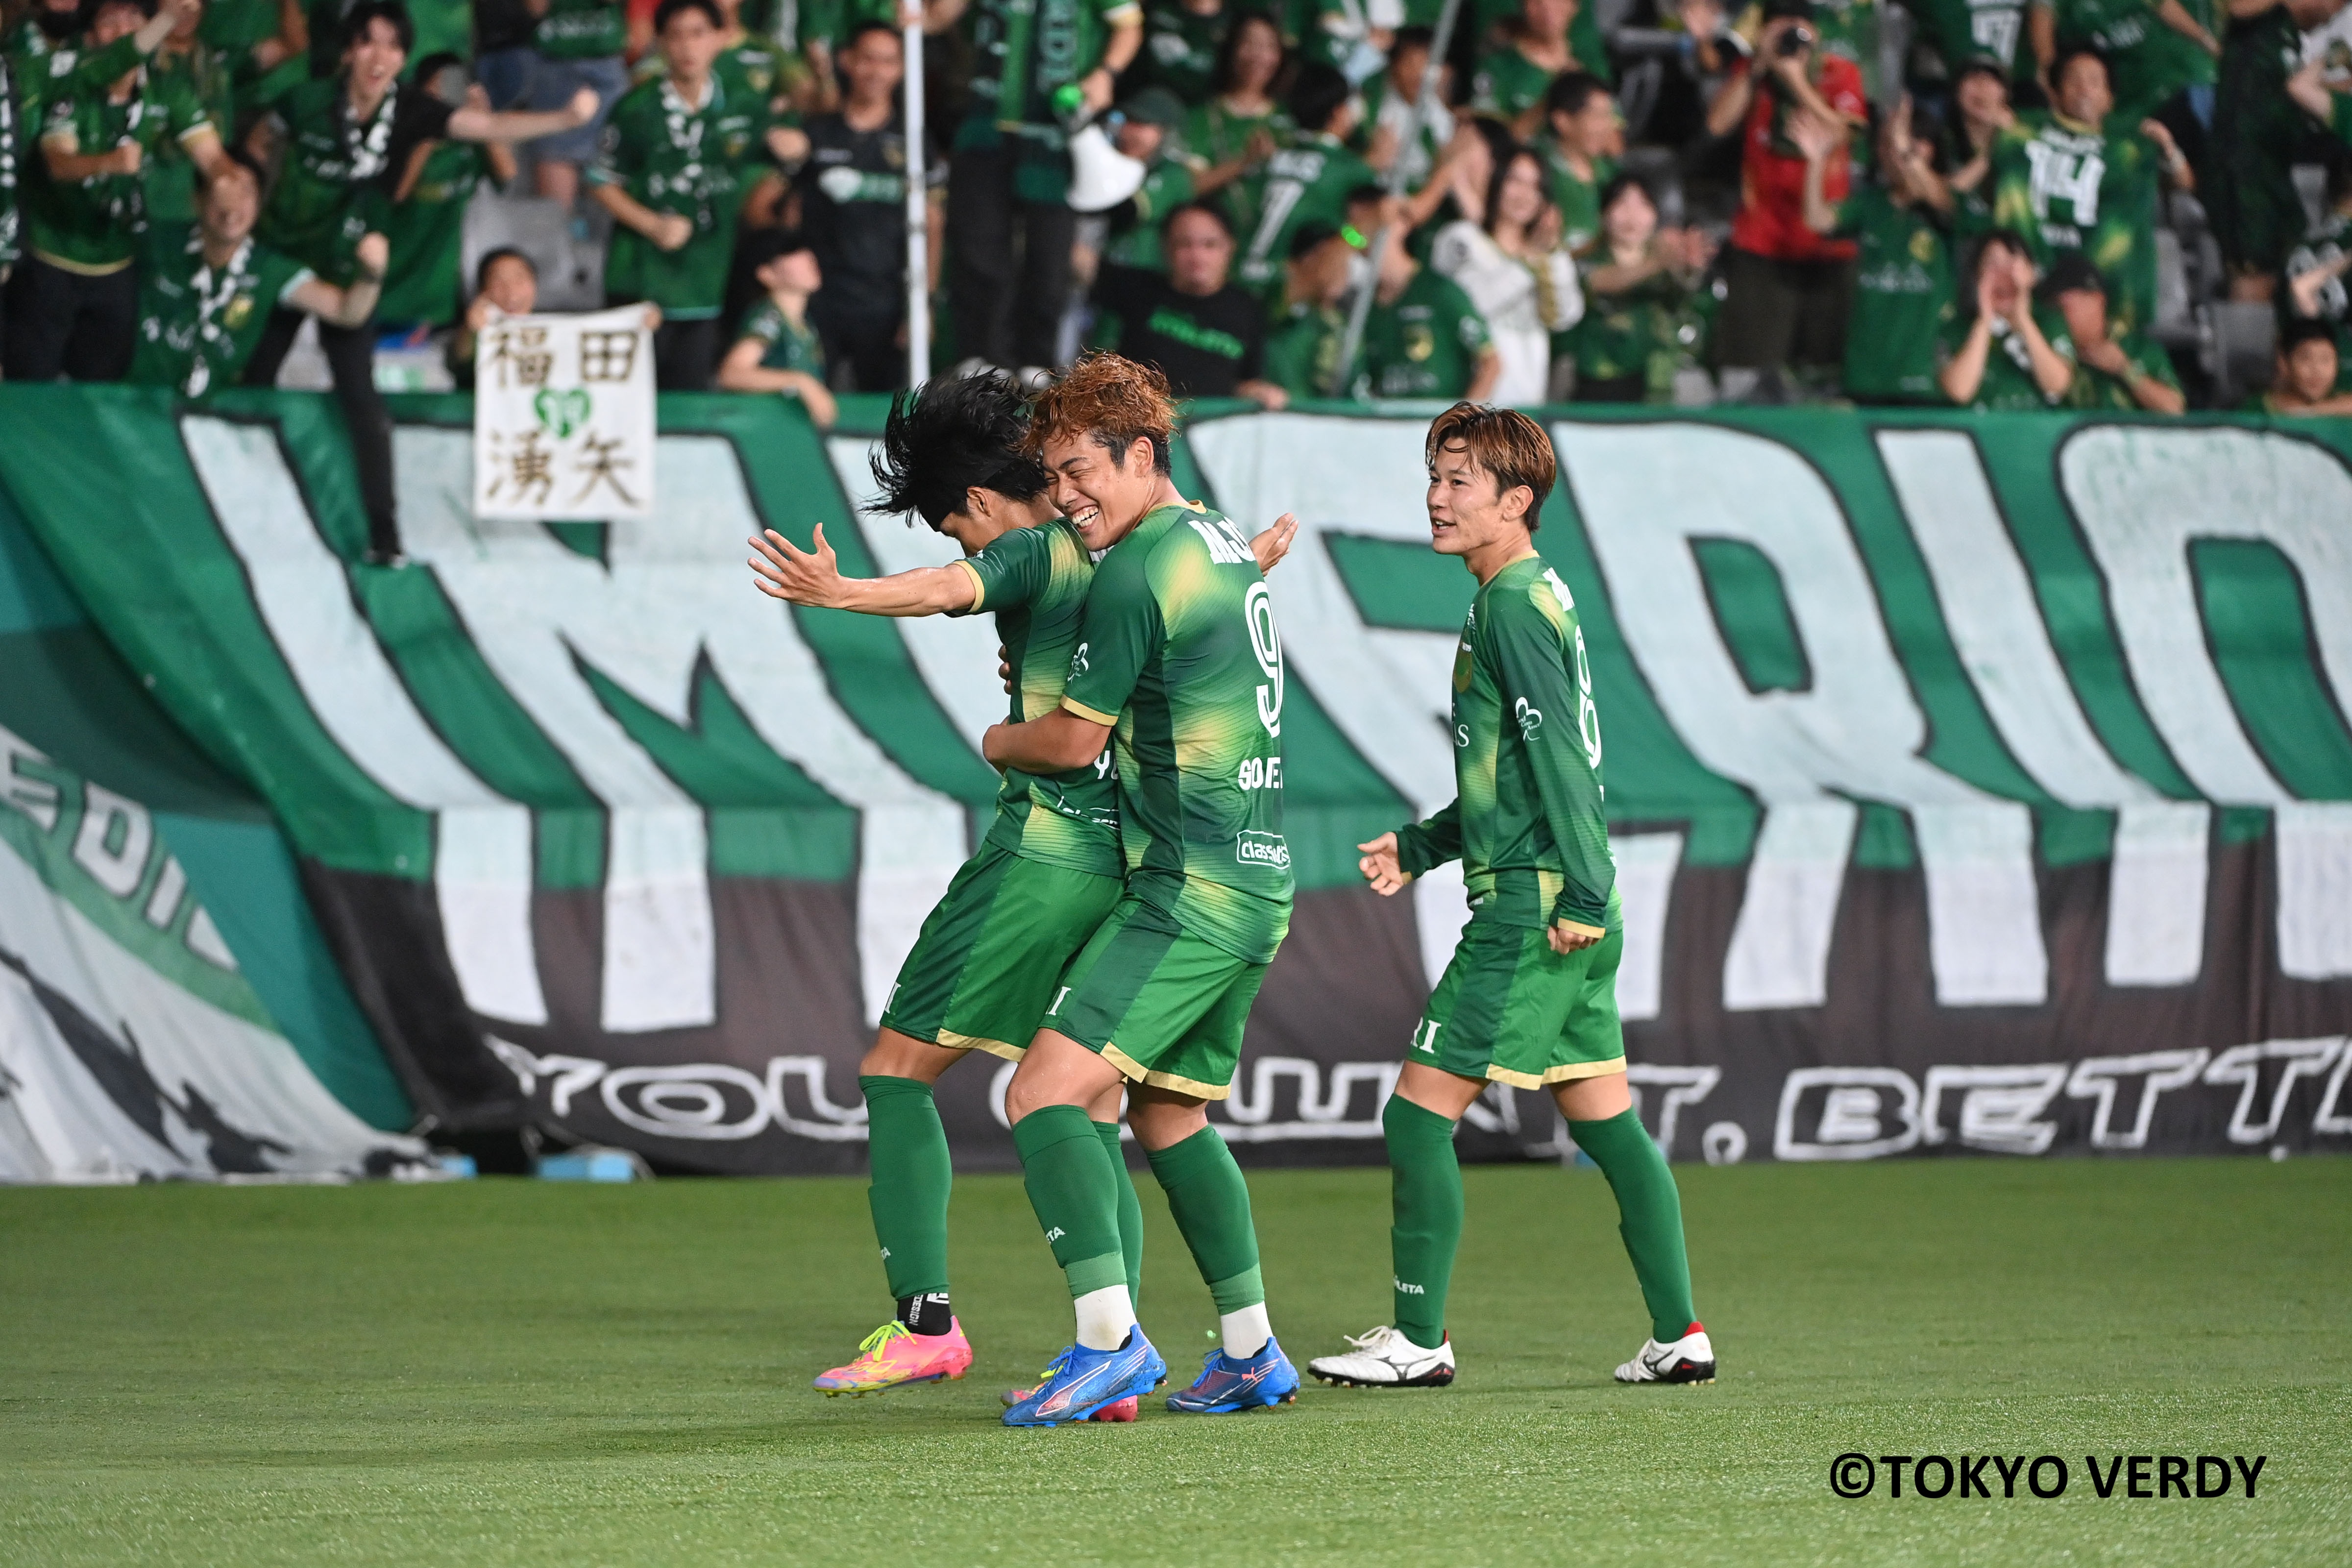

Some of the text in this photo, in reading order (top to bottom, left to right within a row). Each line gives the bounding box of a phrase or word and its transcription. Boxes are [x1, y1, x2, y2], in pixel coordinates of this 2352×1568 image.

[485, 326, 638, 387] 福田
[1245, 581, 1284, 738] 9
[1772, 1034, 2352, 1161] BETT
